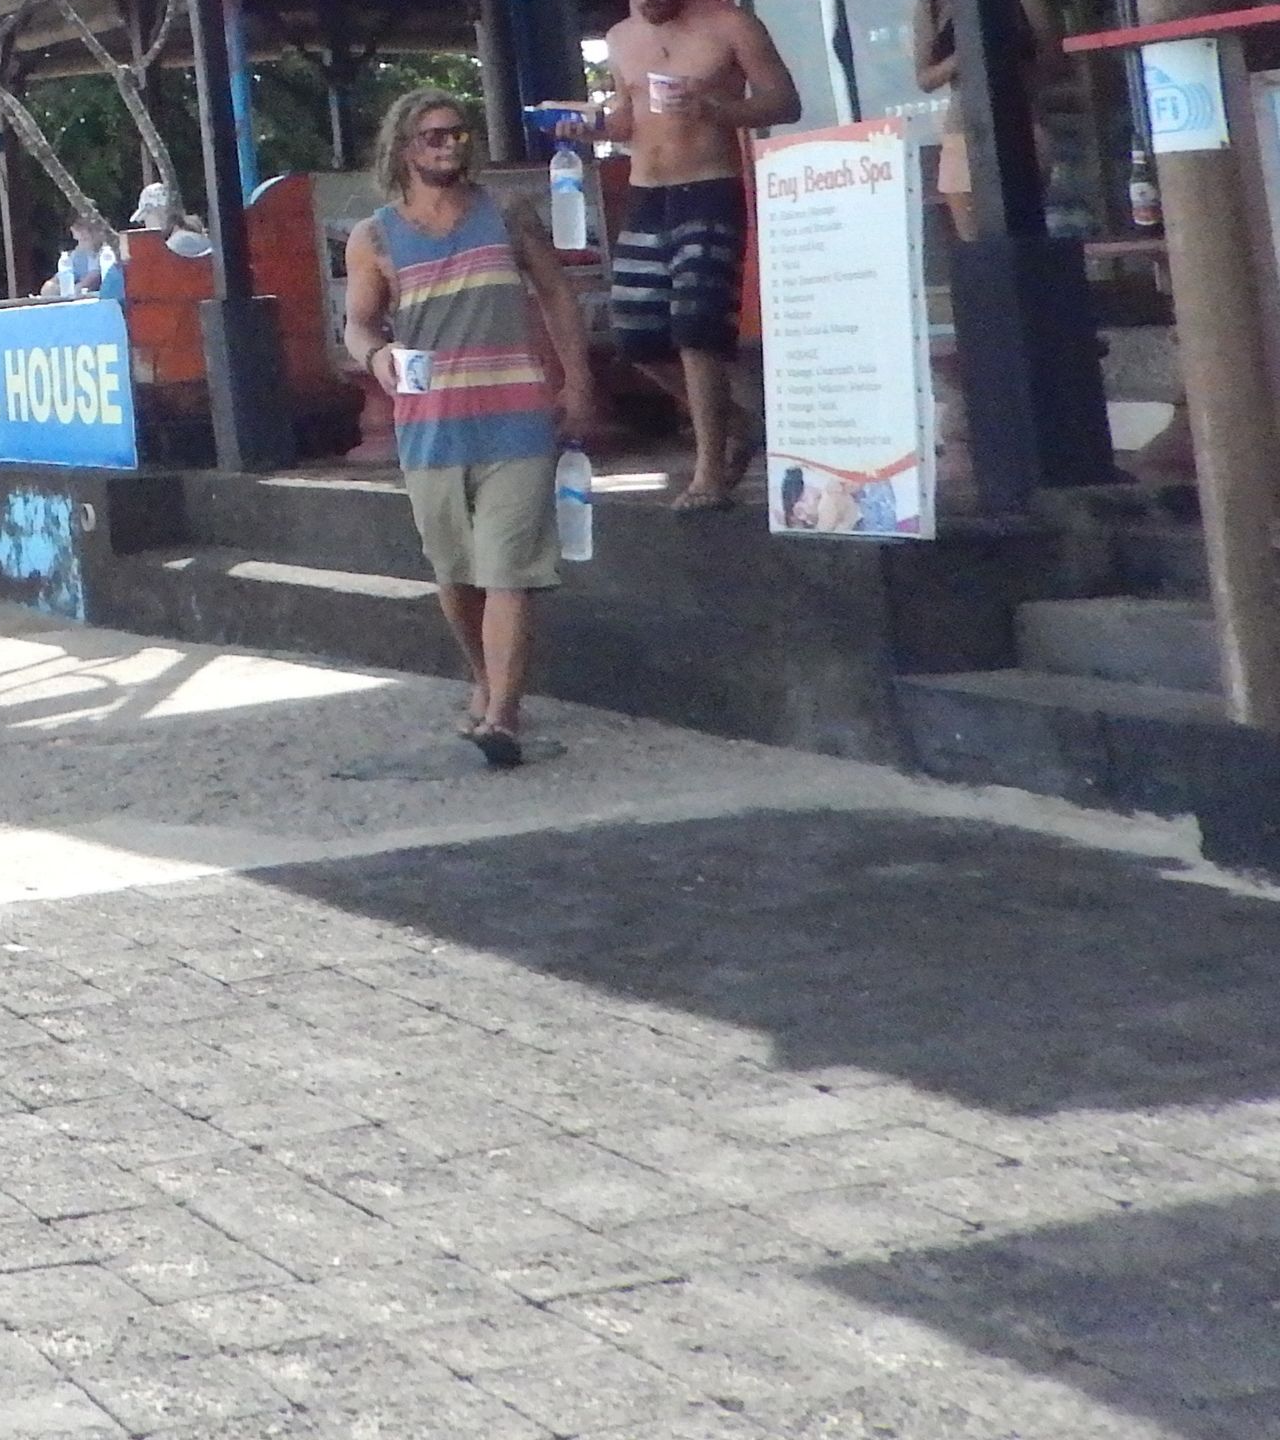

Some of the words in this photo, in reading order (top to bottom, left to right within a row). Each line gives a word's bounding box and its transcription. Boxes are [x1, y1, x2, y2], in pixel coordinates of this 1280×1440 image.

[767, 171, 798, 203] Eny
[803, 158, 855, 193] Beach
[859, 155, 892, 195] Spa
[4, 343, 123, 425] HOUSE
